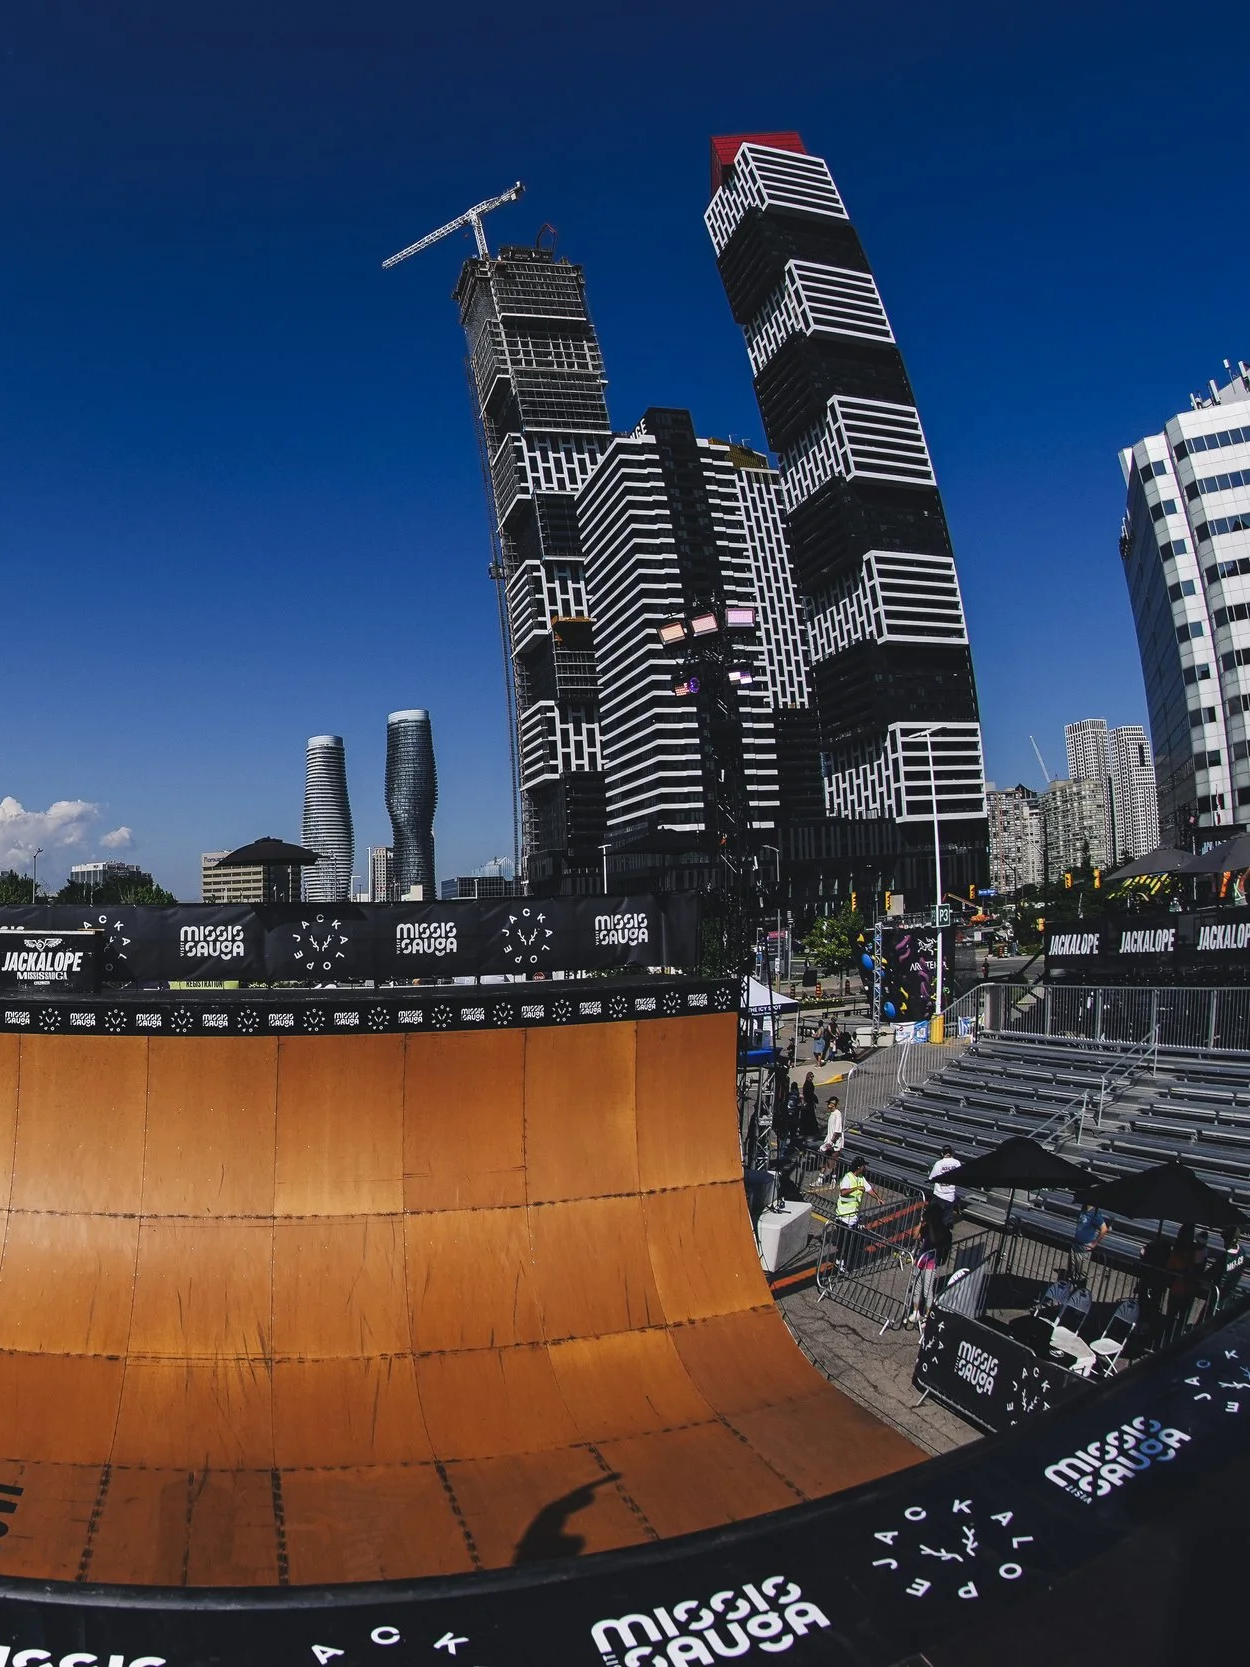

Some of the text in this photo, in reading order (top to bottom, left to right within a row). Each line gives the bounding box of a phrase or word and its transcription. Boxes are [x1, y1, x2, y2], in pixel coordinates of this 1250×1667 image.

[939, 908, 949, 922] P3
[293, 914, 348, 970] JACKALOPE
[502, 908, 553, 964] JACKALOPE
[1048, 933, 1100, 956] JACKALOPE
[1119, 928, 1176, 954] JACKALOPE
[1, 951, 84, 972] JACKALOPE
[16, 971, 68, 980] MISSISSAUGA
[872, 1499, 1034, 1599] JACKALOPE
